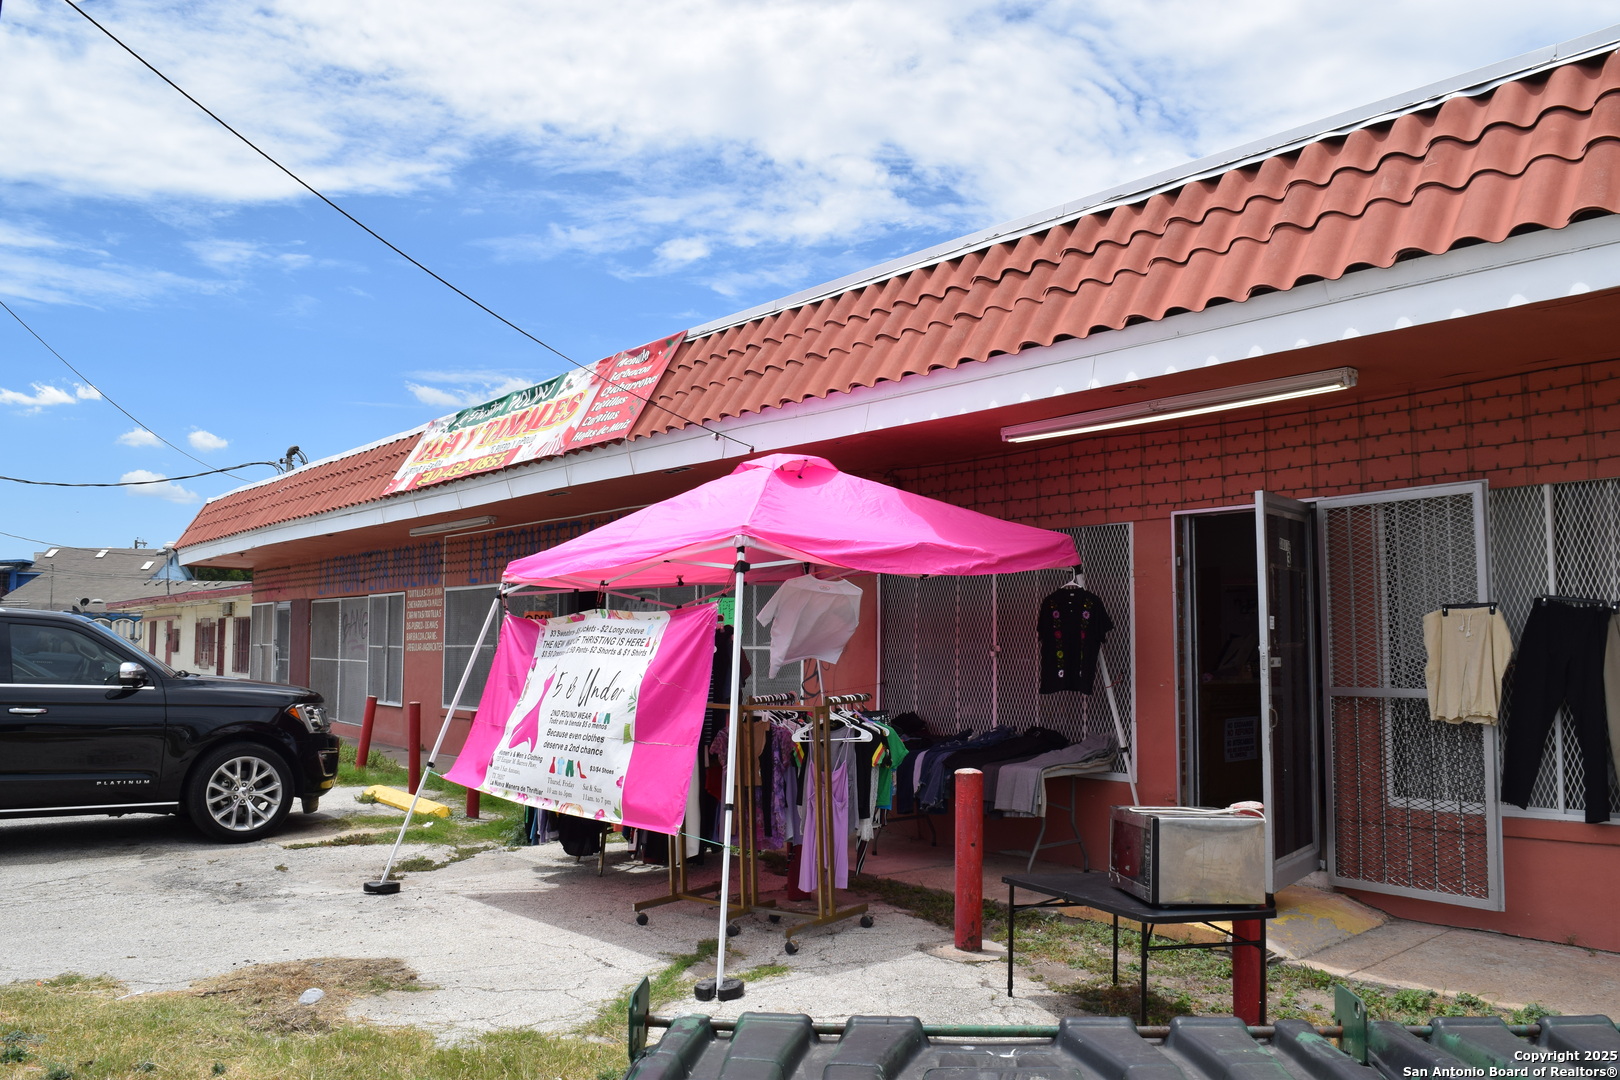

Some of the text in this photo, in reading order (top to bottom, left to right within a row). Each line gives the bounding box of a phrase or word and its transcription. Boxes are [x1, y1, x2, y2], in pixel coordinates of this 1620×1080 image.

[477, 391, 586, 446] TAMALES
[582, 411, 620, 426] Carnitas
[609, 626, 623, 635] Long
[617, 638, 624, 646] IS
[625, 638, 645, 647] HERE
[552, 672, 568, 698] 5
[578, 668, 625, 707] Under
[561, 710, 577, 719] ROUND
[546, 728, 568, 738] Because
[582, 733, 605, 743] clothes
[543, 741, 563, 750] deserve
[569, 744, 580, 752] 2nd
[580, 745, 603, 756] chance
[527, 754, 544, 763] Clothing
[505, 782, 520, 790] Manera
[562, 780, 575, 789] Friday
